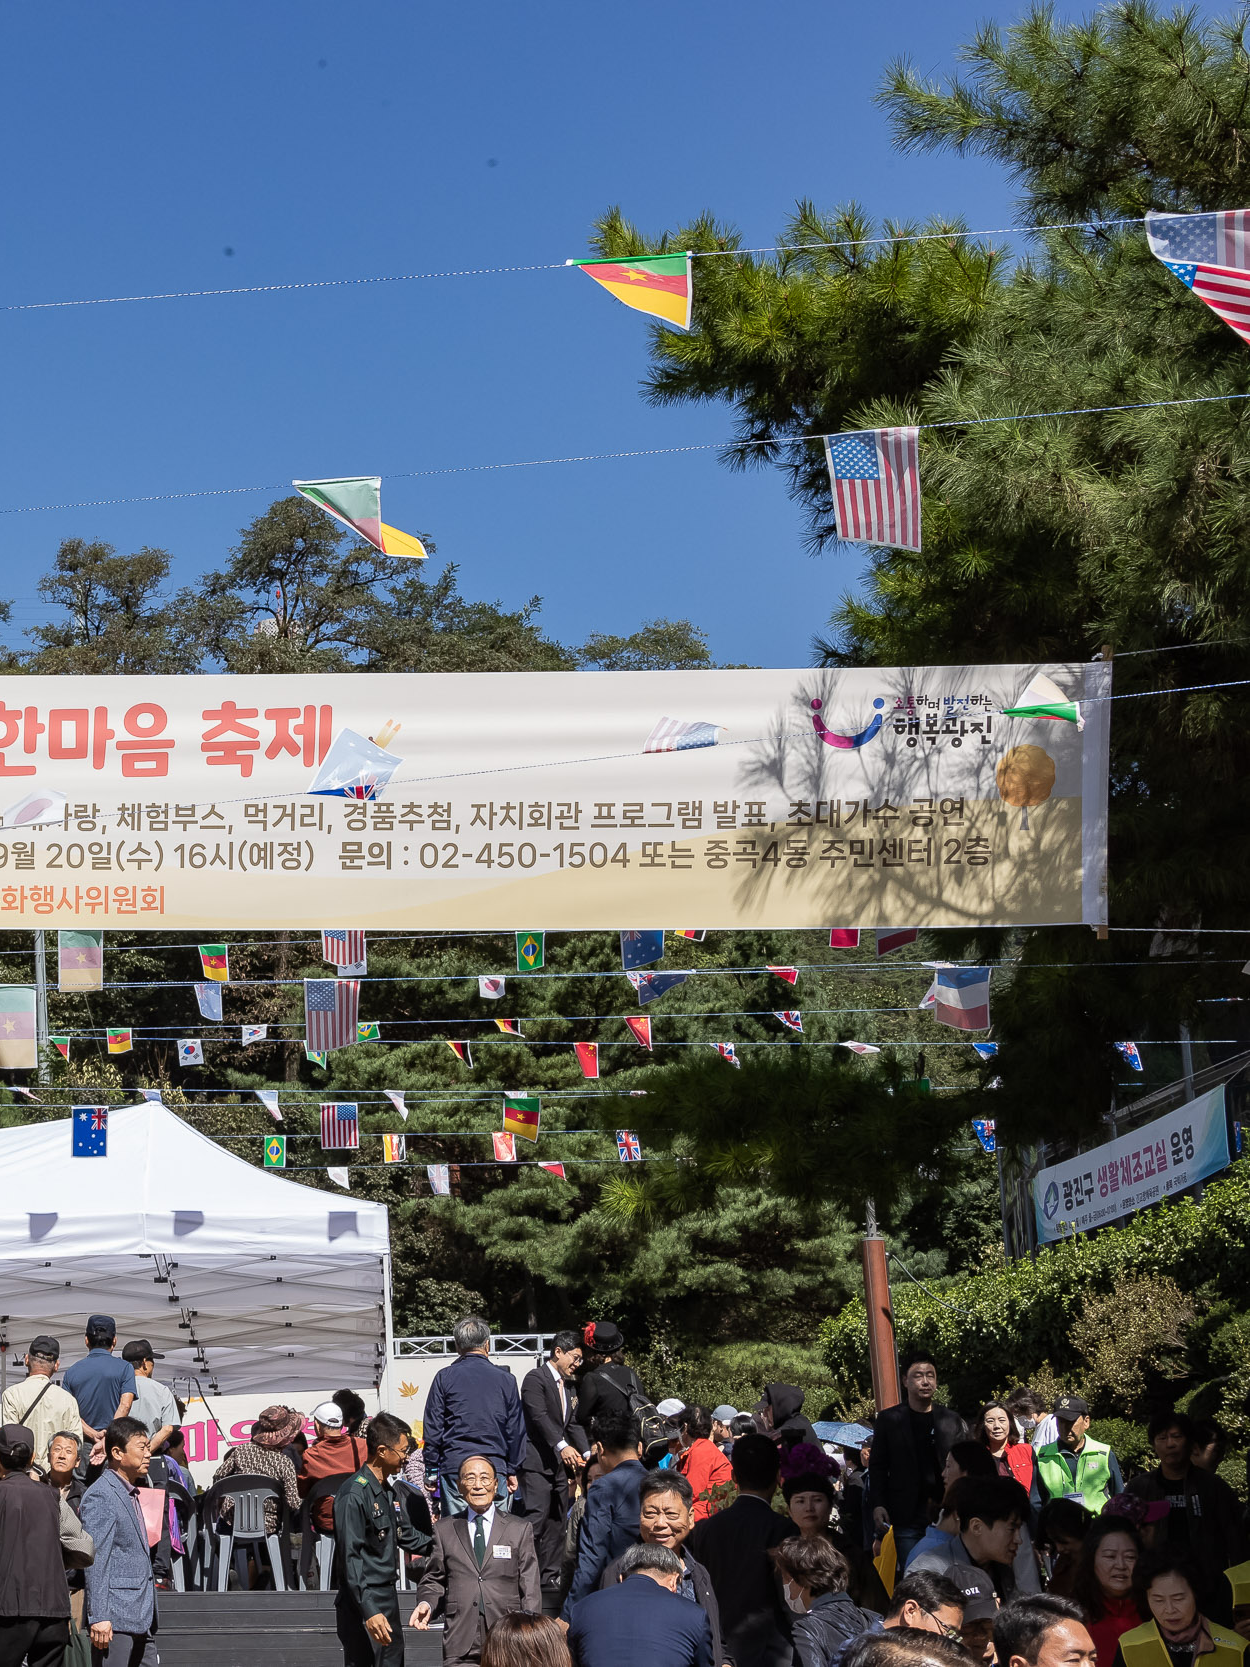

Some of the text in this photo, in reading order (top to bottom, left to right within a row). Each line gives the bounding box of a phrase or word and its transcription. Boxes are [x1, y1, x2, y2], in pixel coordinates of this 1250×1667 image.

[894, 694, 992, 715] 소통하며 발전하는
[201, 701, 336, 777] 축제
[893, 714, 992, 748] 행복광진
[117, 801, 233, 835] 체험부스,
[244, 800, 332, 834] 먹거리,
[344, 799, 460, 834] 경품추첨,
[470, 802, 582, 830] 자치회관
[591, 800, 702, 829] 프로그램
[712, 797, 776, 832] 발표,
[785, 799, 900, 830] 초대가수
[909, 797, 966, 828] 공연
[46, 840, 163, 872] 20일(수)
[174, 840, 314, 872] 16시(예정)
[339, 841, 391, 870] 문의
[420, 842, 630, 868] 02-450-1504
[639, 841, 695, 869] 또는
[704, 840, 811, 868] 중곡4동
[819, 839, 933, 868] 주민센터
[944, 838, 992, 867] 2층
[1062, 1125, 1195, 1211] 광진구 생활체조교실 운영
[961, 1586, 980, 1596] OVA
